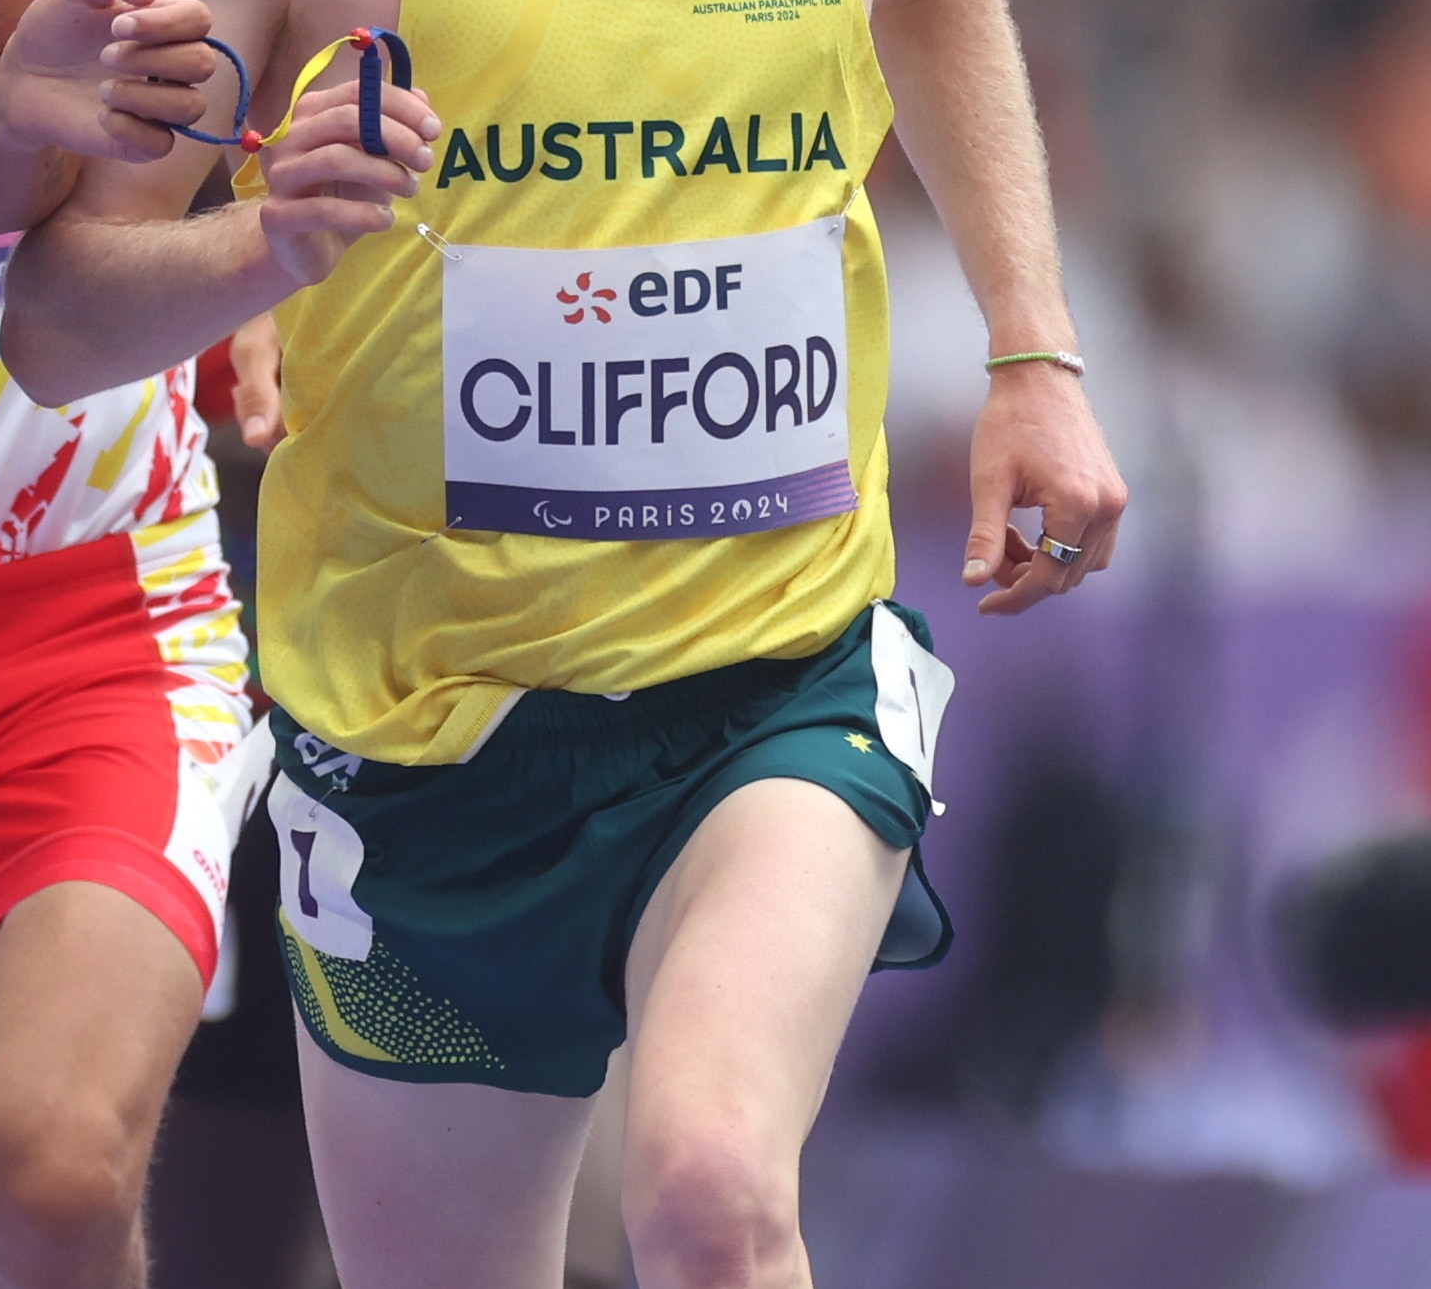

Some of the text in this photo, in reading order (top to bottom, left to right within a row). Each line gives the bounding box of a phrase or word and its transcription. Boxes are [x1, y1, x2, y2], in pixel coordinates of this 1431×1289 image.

[692, 0, 756, 15] AUSTRALIAN
[745, 10, 800, 23] PARIS 2024
[436, 112, 847, 188] AUSTRALIA
[628, 264, 743, 317] eDF
[460, 335, 837, 446] CLIFFORD
[595, 493, 789, 528] PARIS 2024
